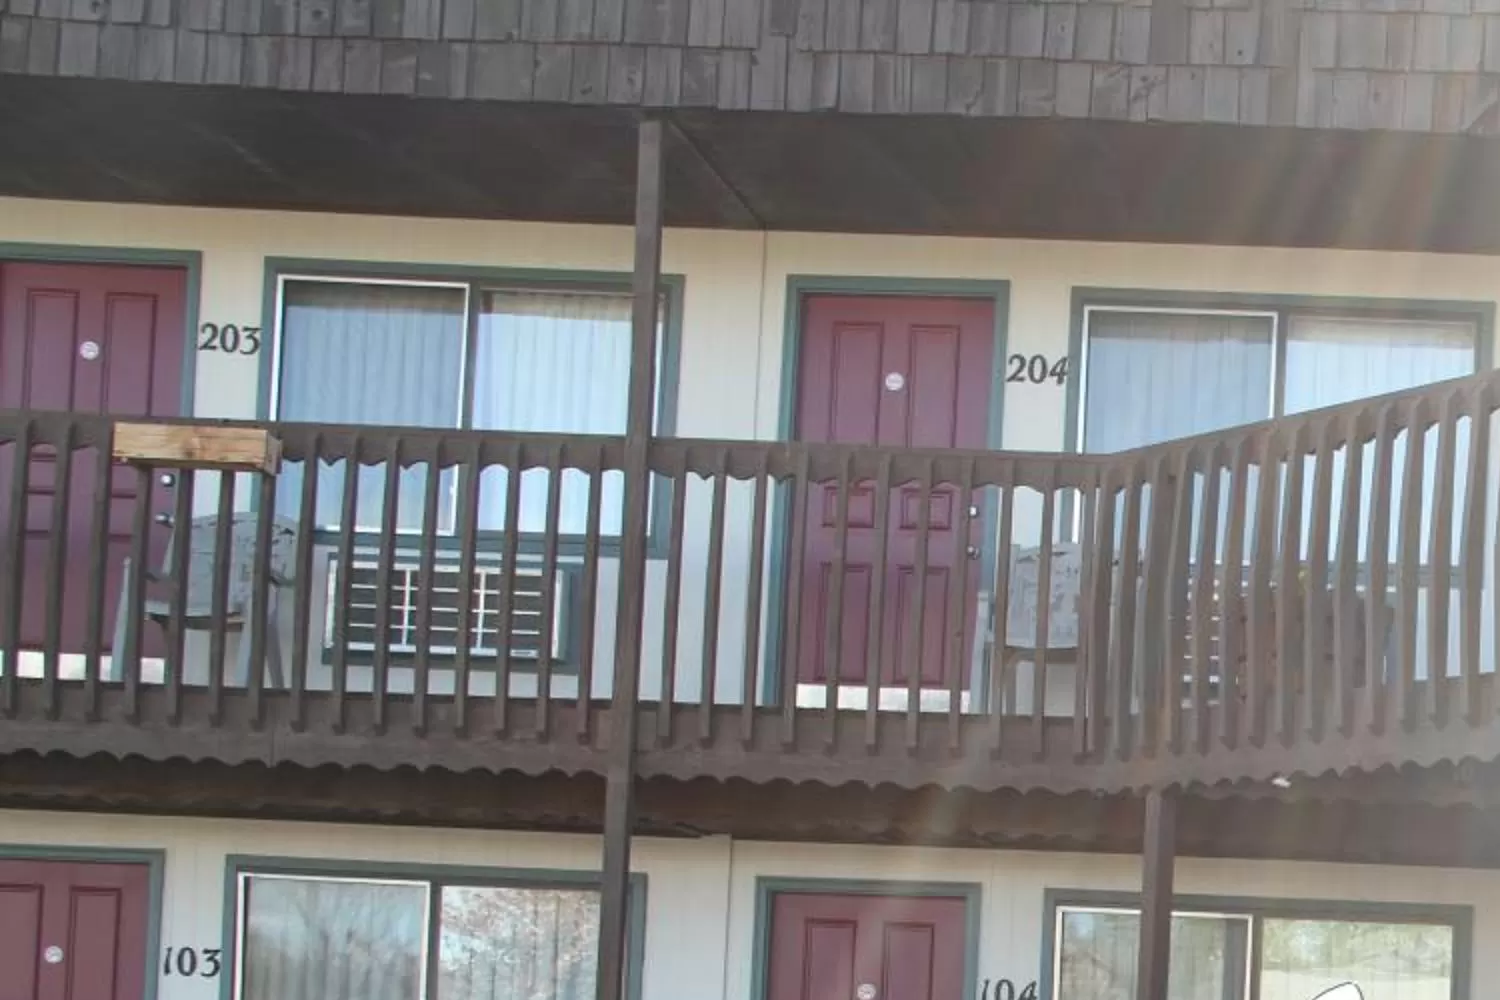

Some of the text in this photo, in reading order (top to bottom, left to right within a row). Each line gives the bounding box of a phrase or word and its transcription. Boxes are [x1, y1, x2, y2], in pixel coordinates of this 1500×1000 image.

[199, 323, 261, 354] 203
[1006, 354, 1070, 385] 204
[163, 946, 221, 977] 103
